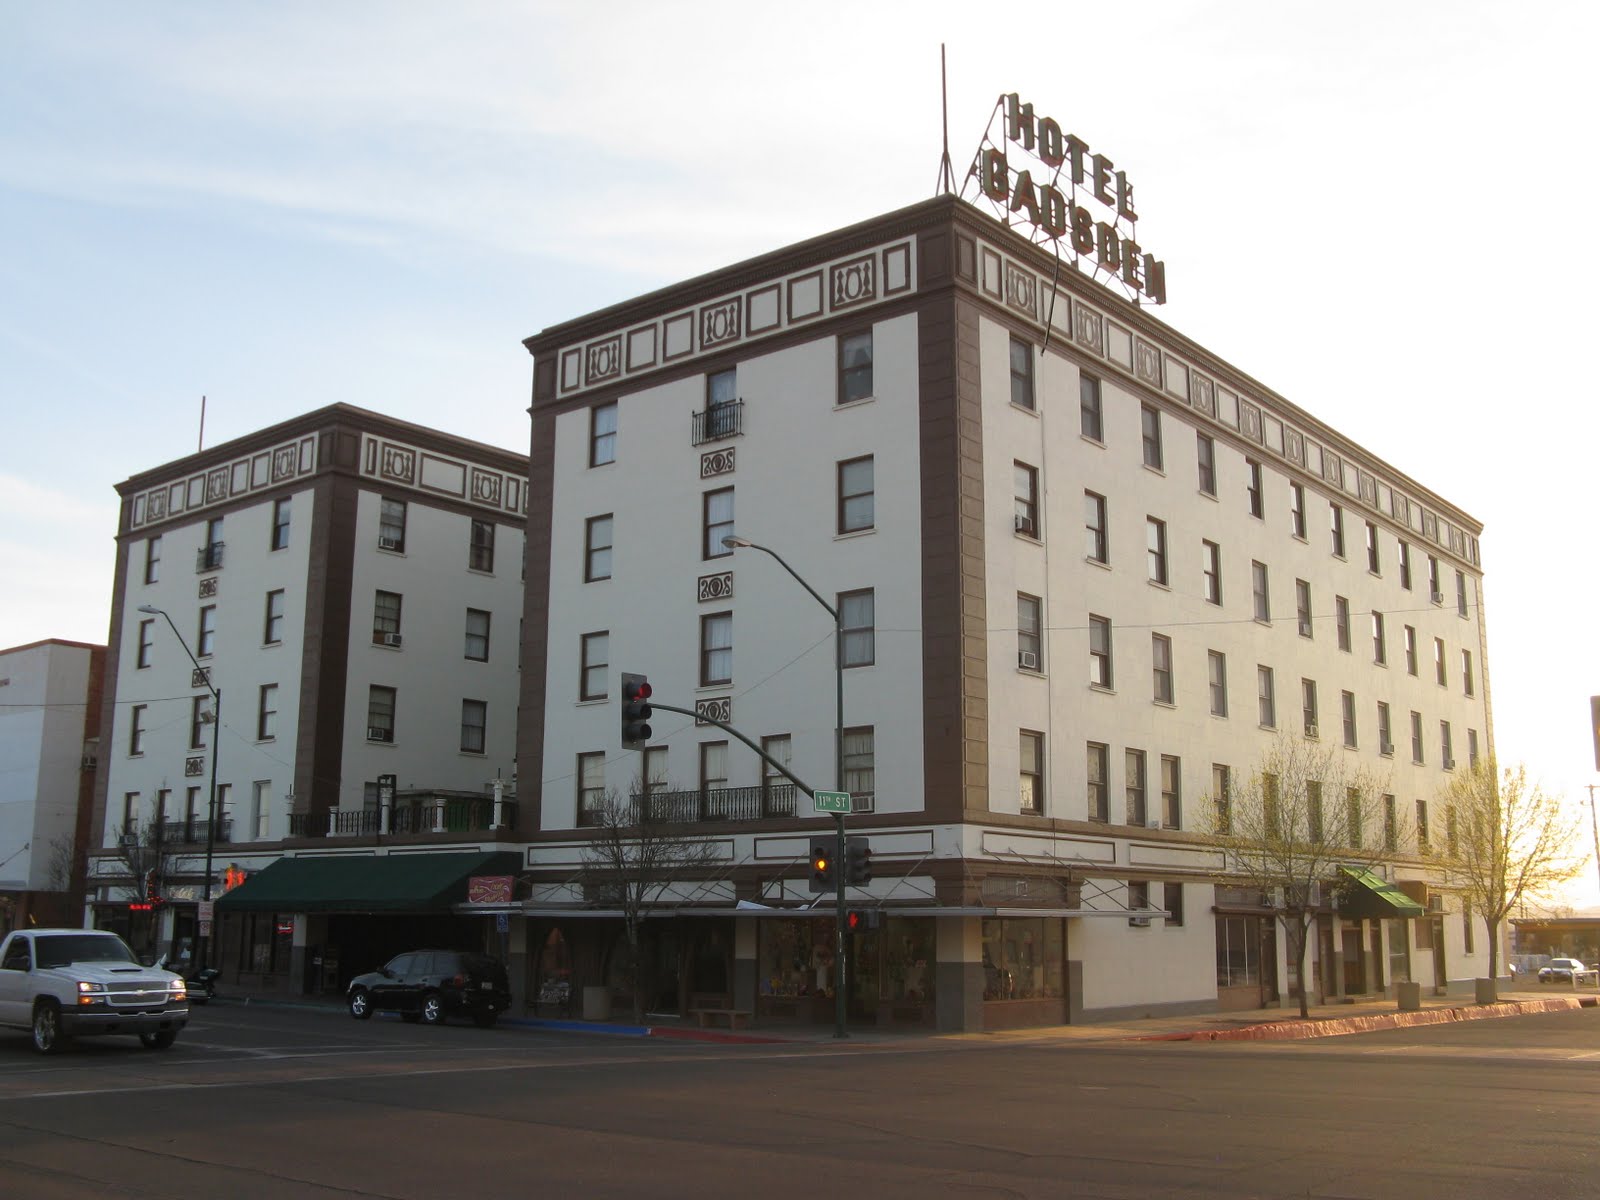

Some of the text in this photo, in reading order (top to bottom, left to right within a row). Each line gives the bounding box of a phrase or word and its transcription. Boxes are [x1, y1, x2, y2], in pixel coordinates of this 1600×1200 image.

[1005, 92, 1139, 223] HOTEL
[981, 148, 1167, 305] GADSDEN
[835, 797, 846, 808] ST
